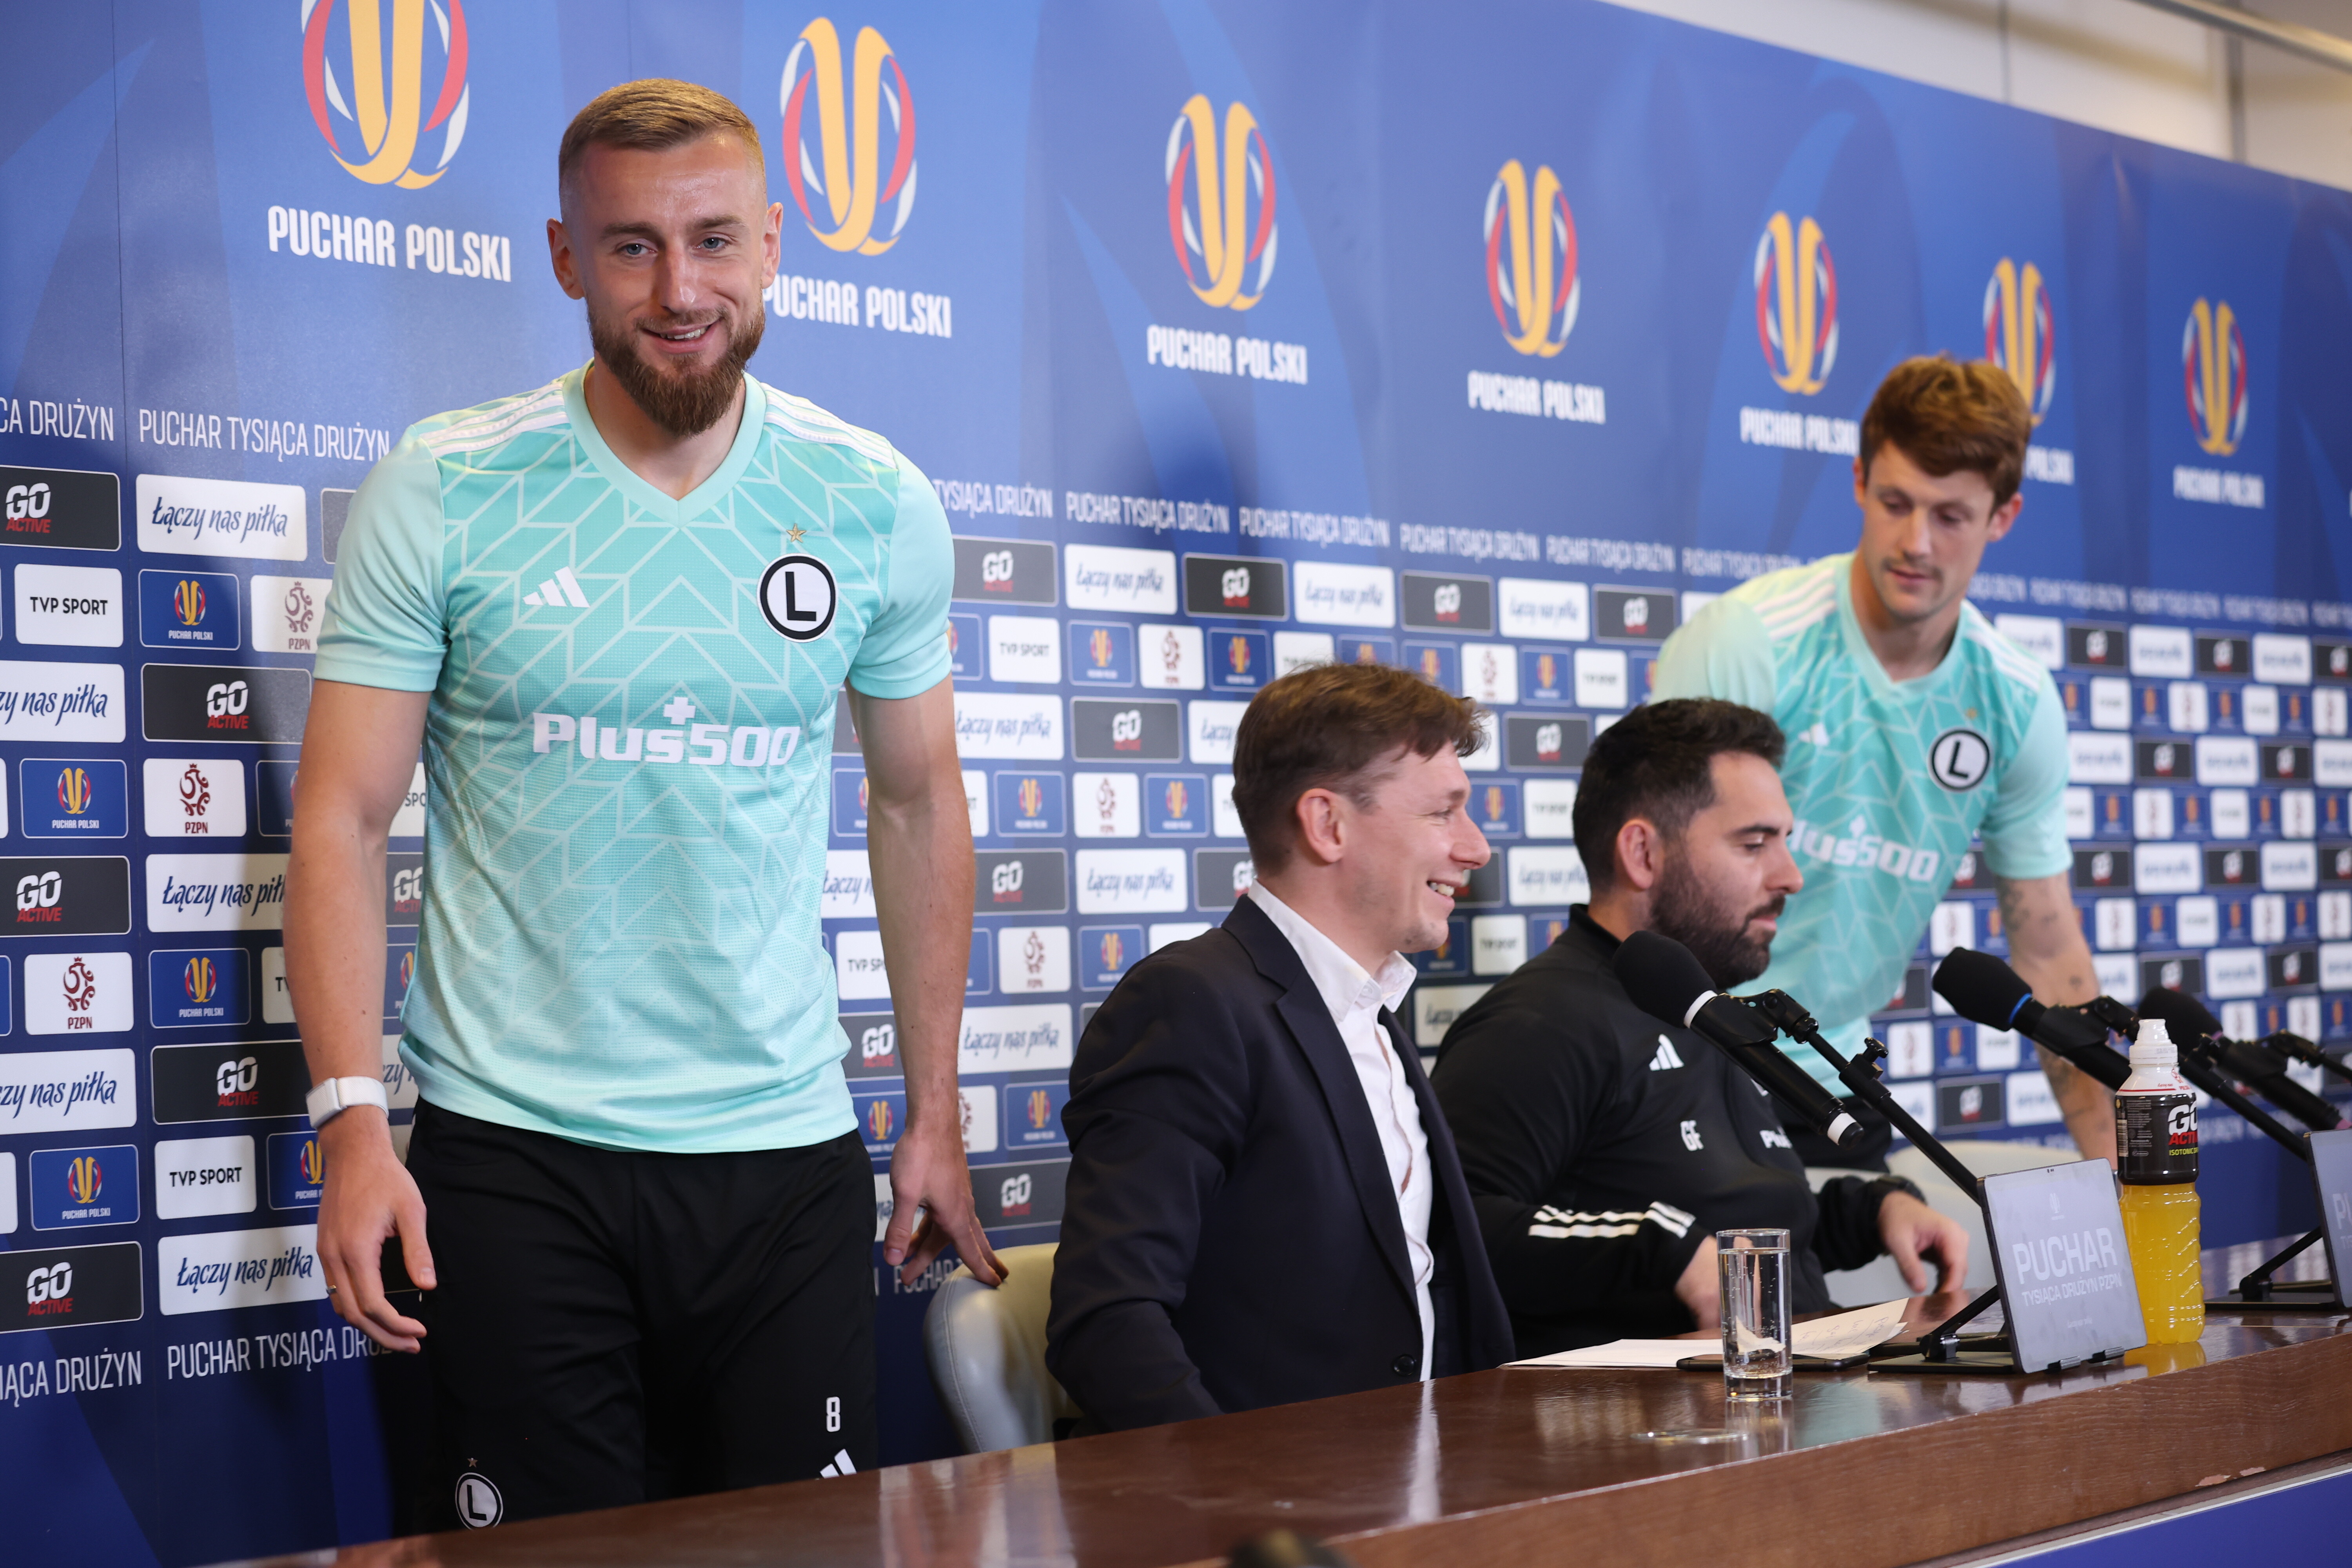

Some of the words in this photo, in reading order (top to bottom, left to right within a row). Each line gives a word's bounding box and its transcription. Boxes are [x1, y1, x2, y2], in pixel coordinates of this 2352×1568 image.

[268, 205, 396, 267] PUCHAR
[405, 224, 511, 282] POLSKI
[763, 273, 858, 327] UCHAR
[866, 286, 951, 338] POLSKI
[1147, 324, 1232, 375] PUCHAR
[1236, 336, 1308, 385] POLSKI
[1467, 370, 1541, 417] PUCHAR
[1543, 379, 1606, 425] POLSKI
[29, 397, 114, 441] DRUŻYN
[139, 408, 222, 450] PUCHAR
[226, 416, 309, 463] TYSIĄCA
[314, 421, 390, 462] DRUŻYN
[5, 483, 51, 520] GO
[995, 483, 1053, 518] DRUŻYN
[1065, 491, 1120, 525] PUCHAR
[5, 517, 51, 534] ACTIVE
[152, 496, 206, 540] Łączy
[209, 505, 241, 534] nas
[240, 503, 288, 544] piłka
[30, 596, 59, 613] TVP
[63, 598, 108, 615] SPORT
[784, 571, 817, 622] L
[168, 630, 191, 639] PUCHAR
[193, 631, 213, 641] POLSKI
[289, 638, 311, 651] PZPN
[22, 692, 58, 716] nas
[54, 684, 108, 726] piłka
[207, 681, 249, 717] GO
[207, 715, 249, 730] ACTIVE
[532, 712, 800, 768] Plus500
[52, 819, 76, 829] PUCHAR
[77, 820, 99, 829] POLSKI
[185, 821, 209, 835] PZPN
[1789, 819, 1940, 882] lus500
[16, 871, 62, 912] GO
[163, 875, 217, 918] Łączy
[220, 880, 254, 908] nas
[252, 875, 287, 918] pił
[394, 900, 421, 913] ACTI
[16, 907, 62, 923] ACTIVE
[67, 1017, 93, 1030] PZPN
[178, 1008, 201, 1018] PUCHAR
[203, 1007, 224, 1017] POLSKI
[862, 1024, 895, 1059] GO
[30, 1083, 66, 1108] nas
[64, 1071, 117, 1116] piłka
[216, 1056, 258, 1096] GO
[218, 1091, 259, 1108] ACTIVE
[169, 1171, 198, 1187] TVP
[200, 1167, 243, 1185] SPORT
[62, 1209, 87, 1220] PUCHAR
[88, 1207, 111, 1218] POLSKI
[177, 1257, 230, 1296] Łączy
[235, 1255, 267, 1283] nas
[265, 1247, 313, 1291] piłka
[2012, 1227, 2118, 1285] PUCHAR
[27, 1261, 73, 1305] GO
[2022, 1284, 2062, 1306] TYSIĄCA
[2062, 1276, 2098, 1299] DRUŻYN
[2099, 1272, 2123, 1291] PZPN
[28, 1298, 73, 1316] ACTIVE
[167, 1338, 250, 1380] PUCHAR
[255, 1328, 337, 1372] TYSIĄCA
[0, 1361, 49, 1408] IĄCA
[55, 1347, 142, 1394] DRUŻYN
[826, 1396, 841, 1433] 8
[466, 1484, 488, 1521] L
